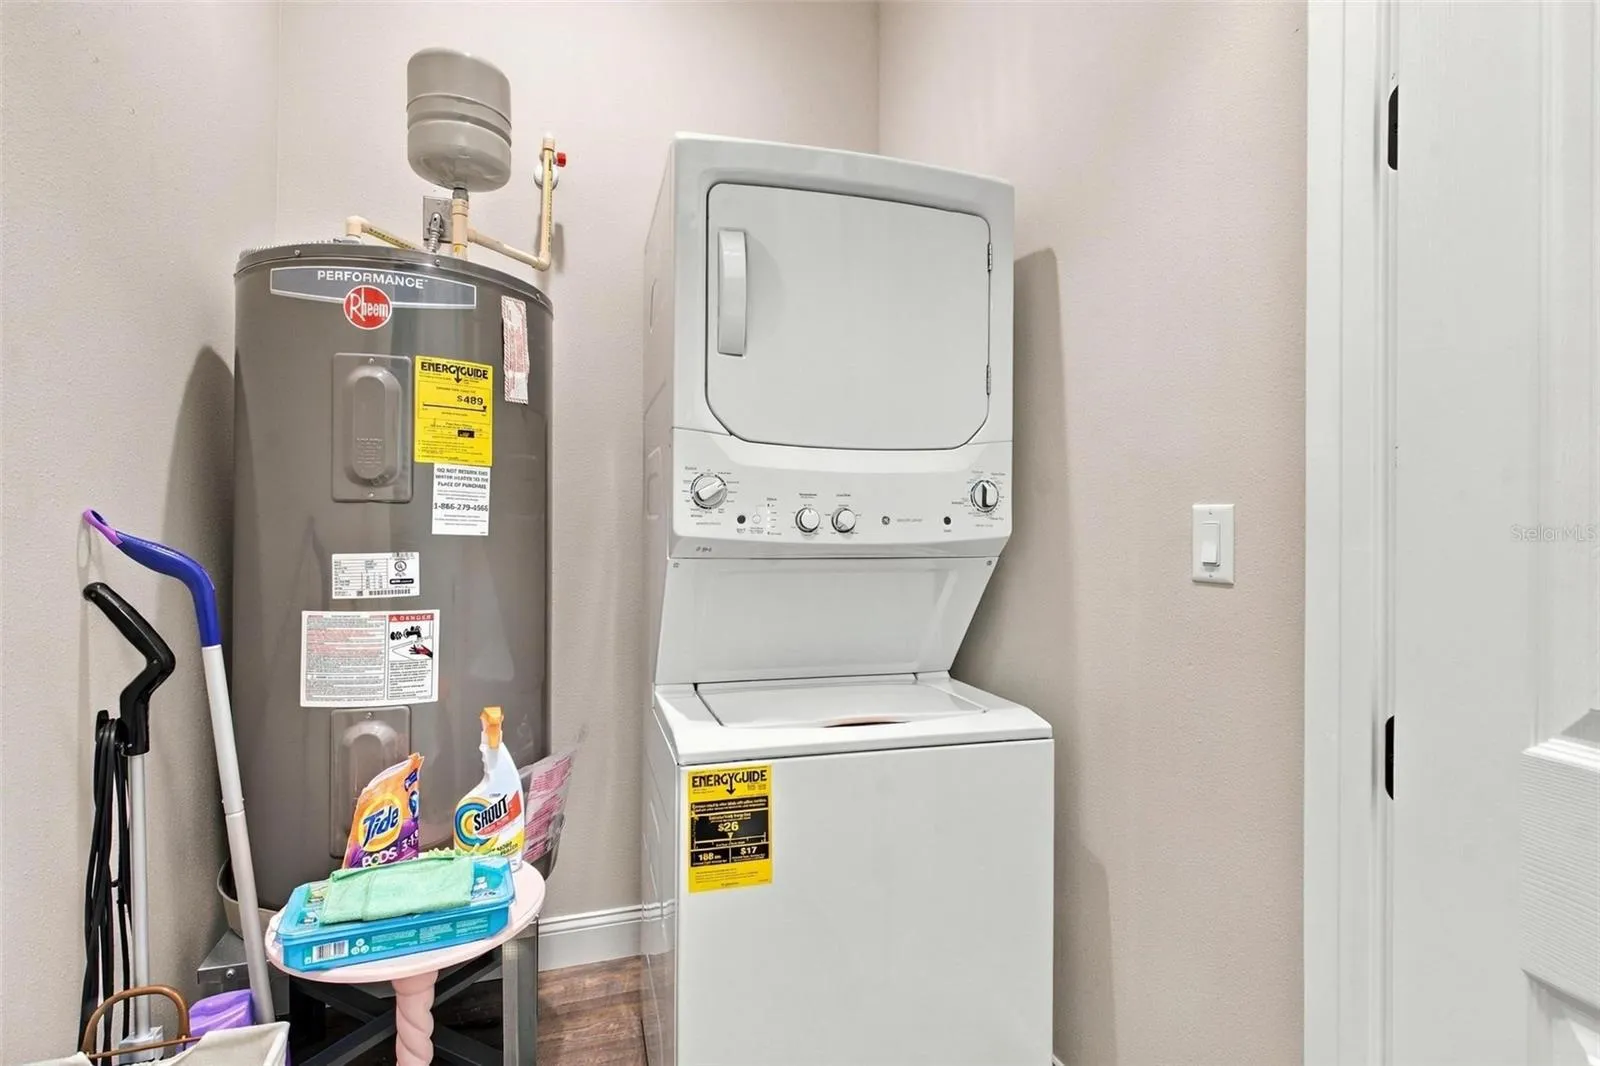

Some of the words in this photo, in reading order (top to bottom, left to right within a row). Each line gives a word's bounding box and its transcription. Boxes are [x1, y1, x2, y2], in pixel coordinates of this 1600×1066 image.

[317, 270, 424, 289] PERFORMANCE
[350, 287, 389, 321] Rheem
[457, 395, 484, 406] $489
[692, 770, 768, 788] ENERGYGUIDE
[474, 794, 508, 831] SHOUT
[363, 806, 400, 847] Tide
[717, 822, 740, 832] $26
[362, 847, 398, 868] PODS
[740, 846, 758, 854] $17
